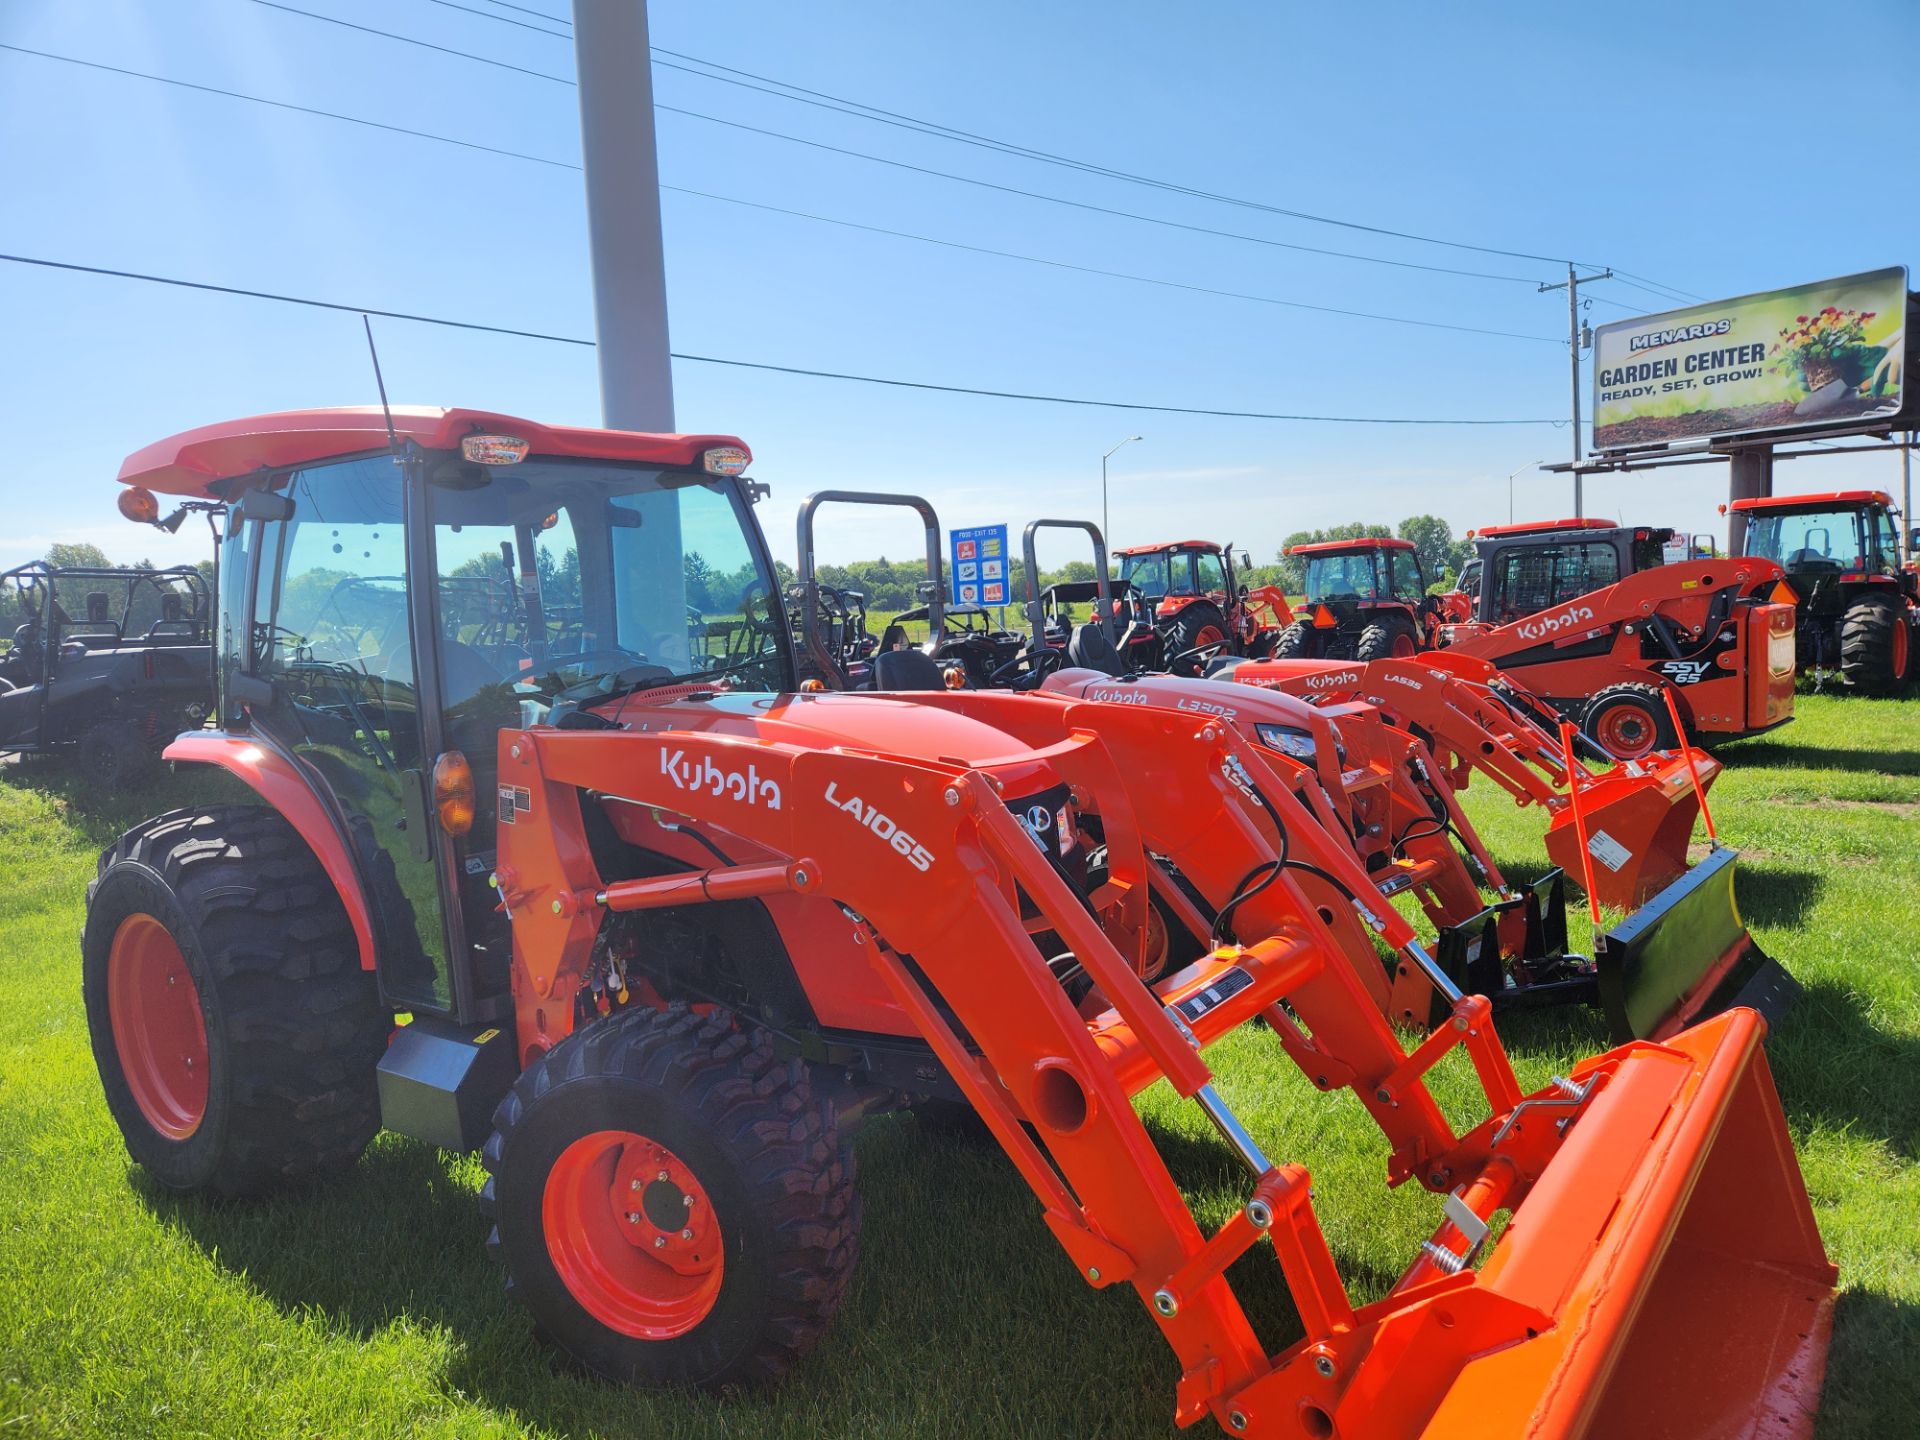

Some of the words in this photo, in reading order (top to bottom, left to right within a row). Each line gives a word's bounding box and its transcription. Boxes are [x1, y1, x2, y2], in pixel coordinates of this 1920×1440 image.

[1630, 319, 1731, 351] MENARDS
[1600, 357, 1677, 388] GARDEN
[1684, 343, 1765, 373] CENTER
[1602, 385, 1656, 402] READY,
[1662, 378, 1697, 393] SET,
[1703, 368, 1762, 386] GROW!
[1517, 607, 1594, 639] Kubota
[1306, 671, 1358, 688] Kubota
[1661, 661, 1711, 673] SSV
[1675, 673, 1701, 683] 65
[661, 747, 781, 810] Kubota
[824, 782, 935, 872] LA1065
